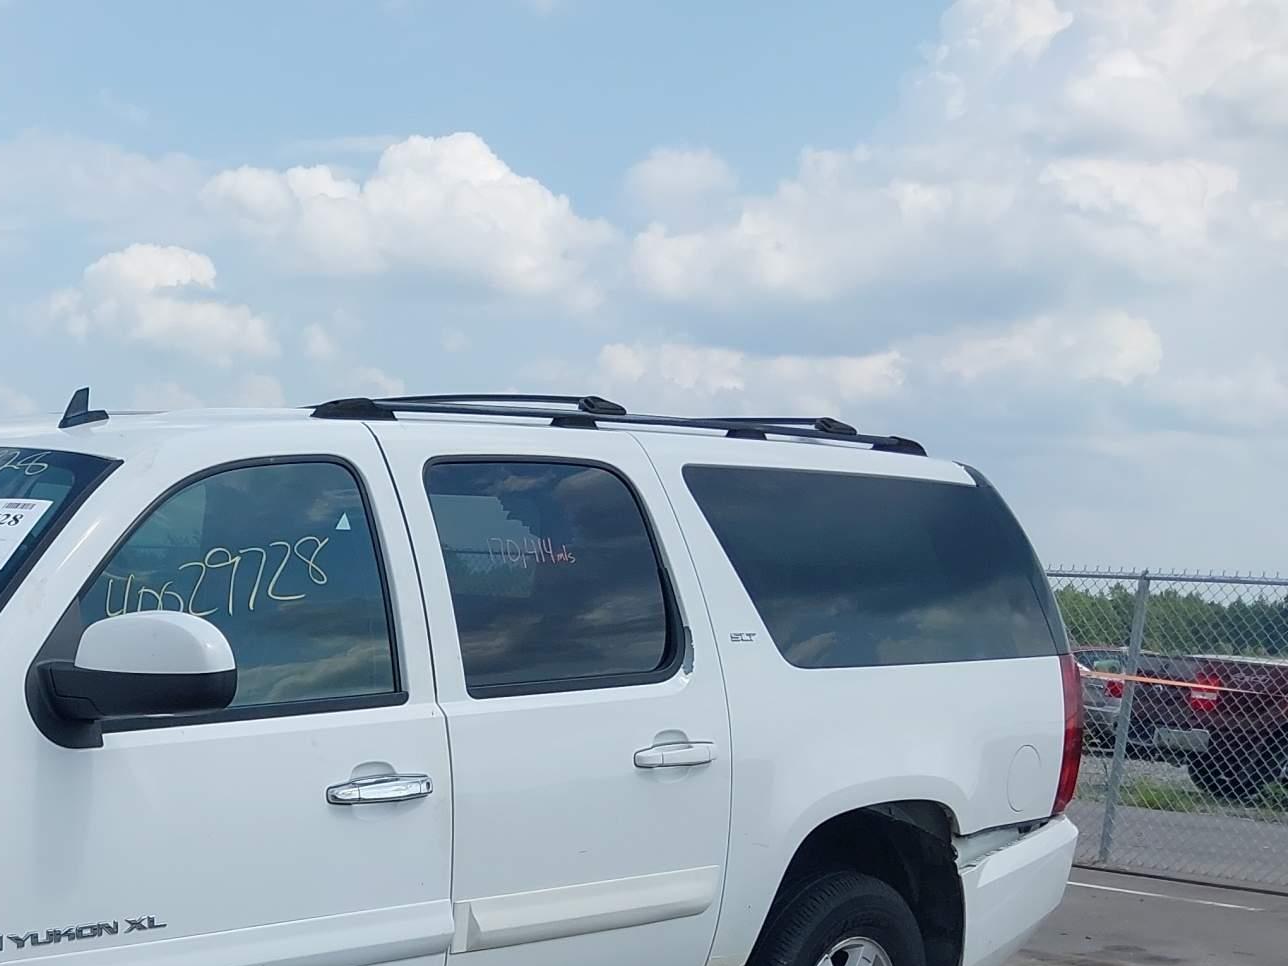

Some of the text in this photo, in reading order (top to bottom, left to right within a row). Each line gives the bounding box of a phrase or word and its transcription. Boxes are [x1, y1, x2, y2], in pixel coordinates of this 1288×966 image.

[730, 632, 757, 642] SLT
[7, 920, 119, 949] YUKON
[124, 914, 168, 934] XL
